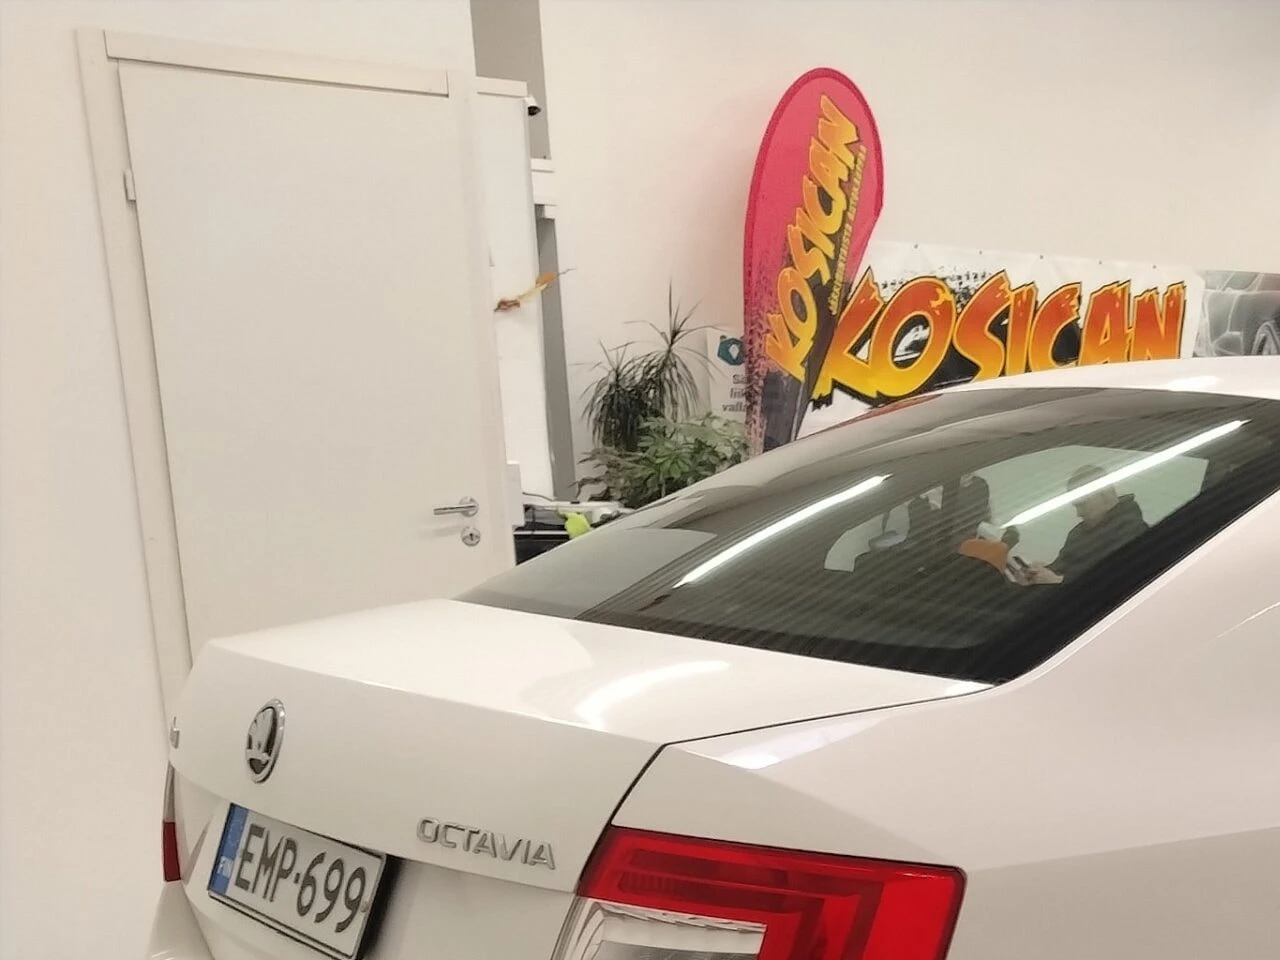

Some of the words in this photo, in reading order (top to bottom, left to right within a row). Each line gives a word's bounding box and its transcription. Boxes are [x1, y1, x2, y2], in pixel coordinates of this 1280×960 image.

[764, 93, 861, 382] KOSICAN
[808, 264, 1187, 408] KOSICAN
[234, 823, 367, 933] EMP-699
[416, 816, 556, 871] OCTAVIA
